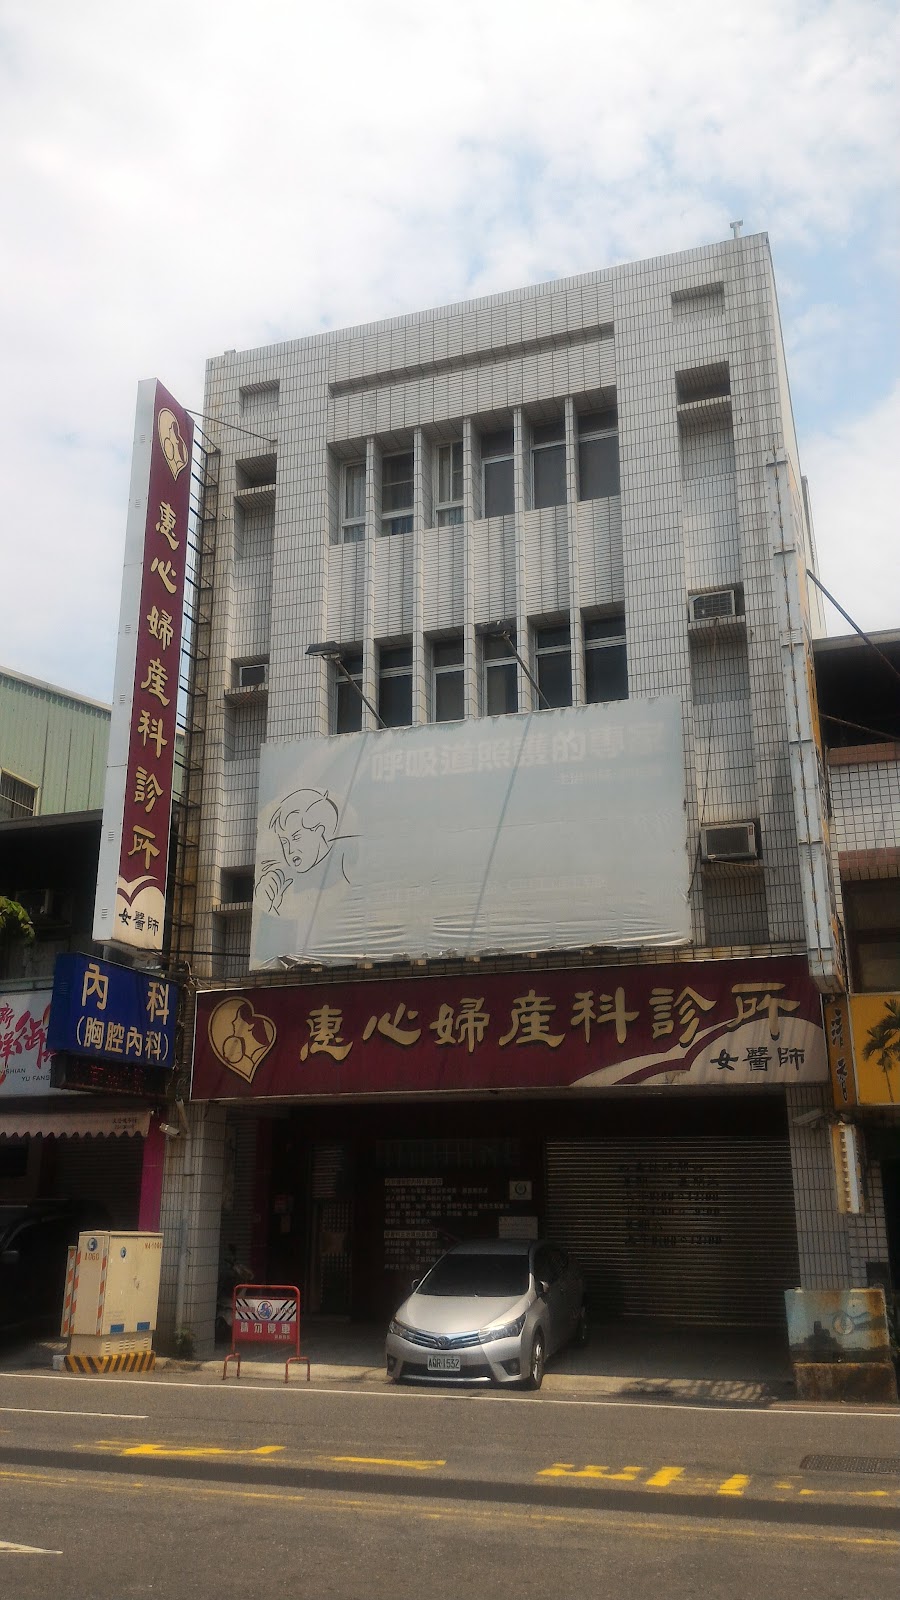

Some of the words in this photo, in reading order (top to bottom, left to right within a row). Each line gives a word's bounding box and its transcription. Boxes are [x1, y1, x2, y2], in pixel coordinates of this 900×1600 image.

[118, 907, 159, 936] 女醫師
[710, 1047, 805, 1071] 女醫師
